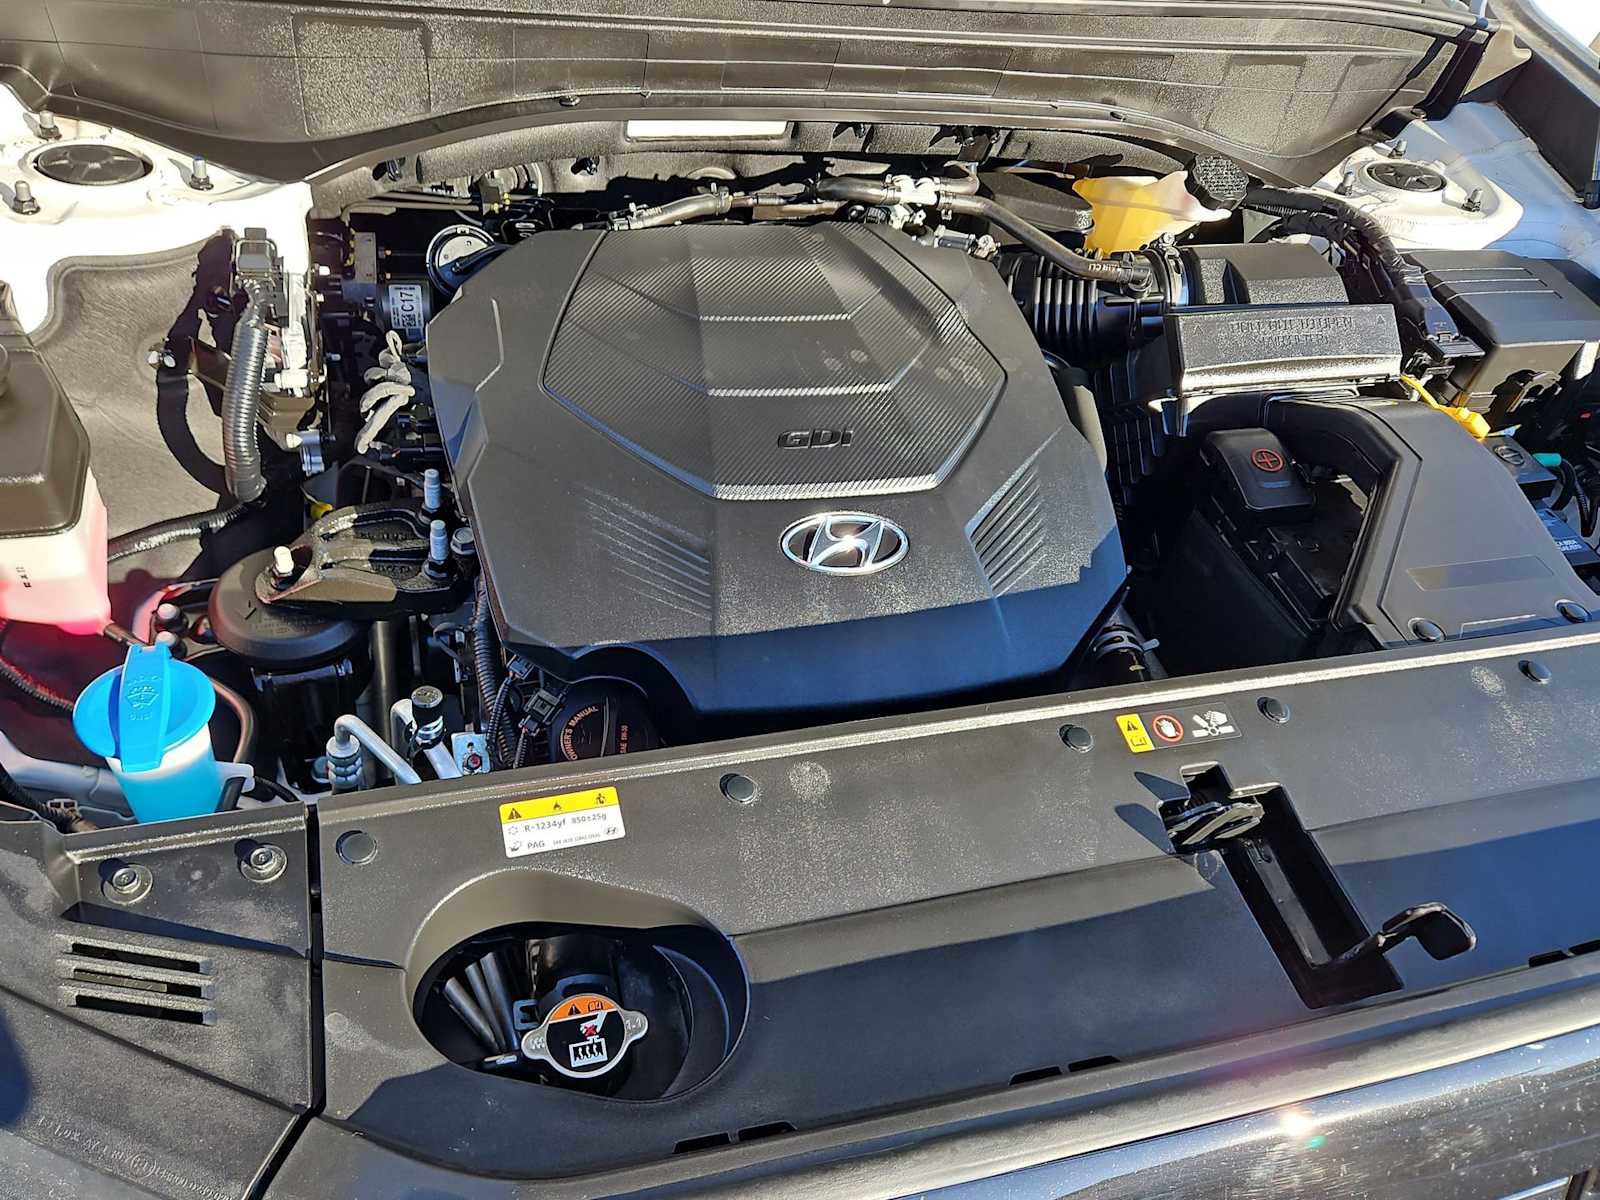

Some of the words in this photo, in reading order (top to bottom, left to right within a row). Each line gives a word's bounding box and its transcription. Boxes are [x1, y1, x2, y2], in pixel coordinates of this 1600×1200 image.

[778, 429, 854, 449] GDI
[568, 705, 600, 728] MANUAL
[563, 728, 579, 760] OWNER'S
[524, 818, 566, 833] R-1234yf
[527, 840, 546, 850] PAG
